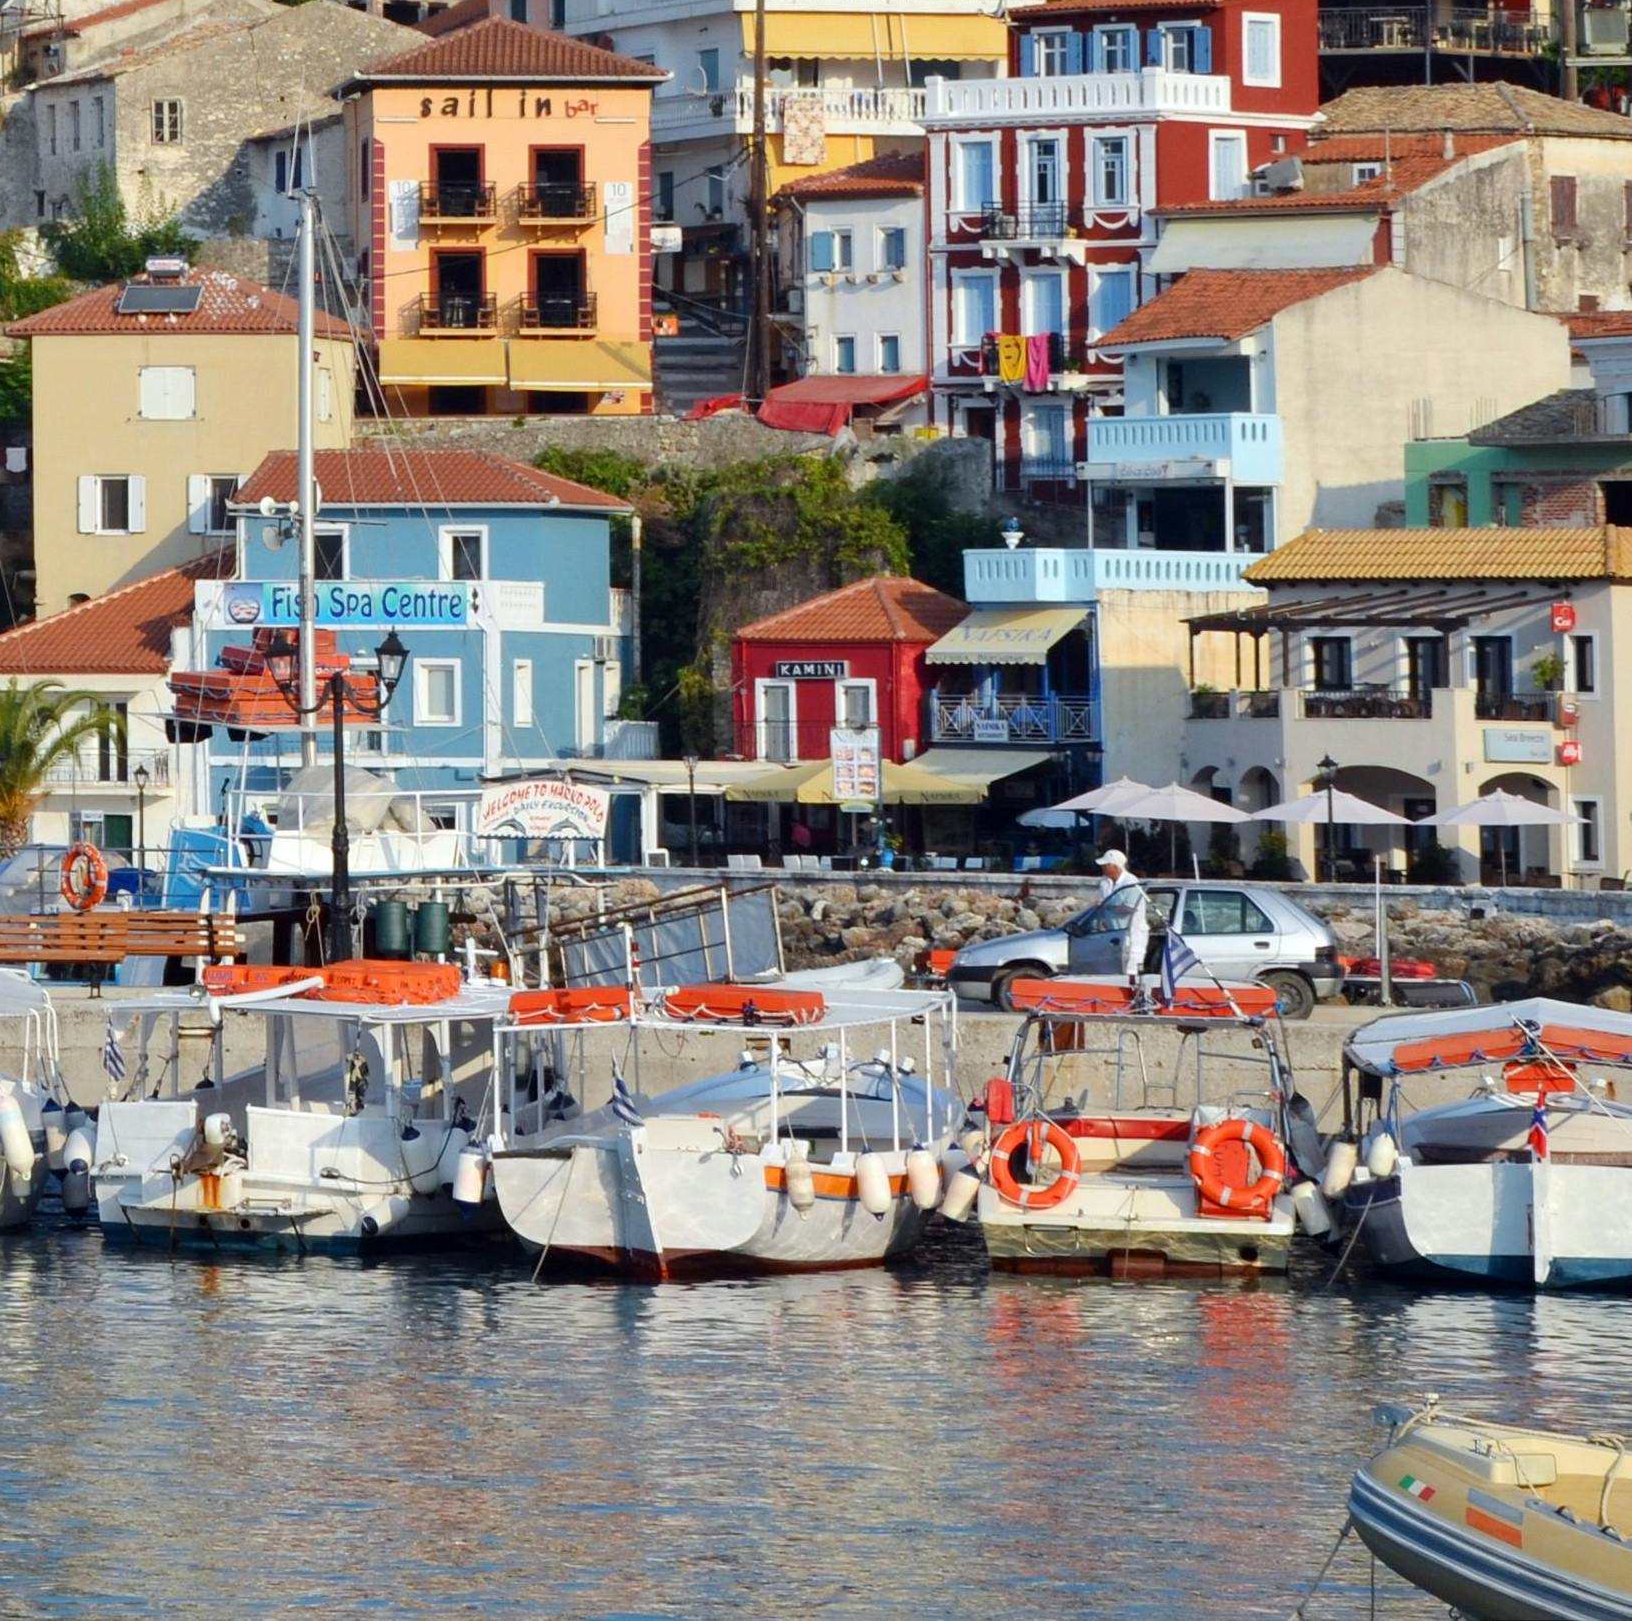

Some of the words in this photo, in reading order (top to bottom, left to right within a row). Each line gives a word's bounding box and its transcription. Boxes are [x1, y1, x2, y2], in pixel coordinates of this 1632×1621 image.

[420, 88, 493, 118] sail
[519, 89, 552, 118] in
[564, 98, 599, 118] bar
[612, 183, 626, 196] 10
[330, 586, 372, 618] Spa
[382, 586, 462, 618] Centre
[780, 664, 841, 675] KAMINI
[534, 783, 547, 797] TO
